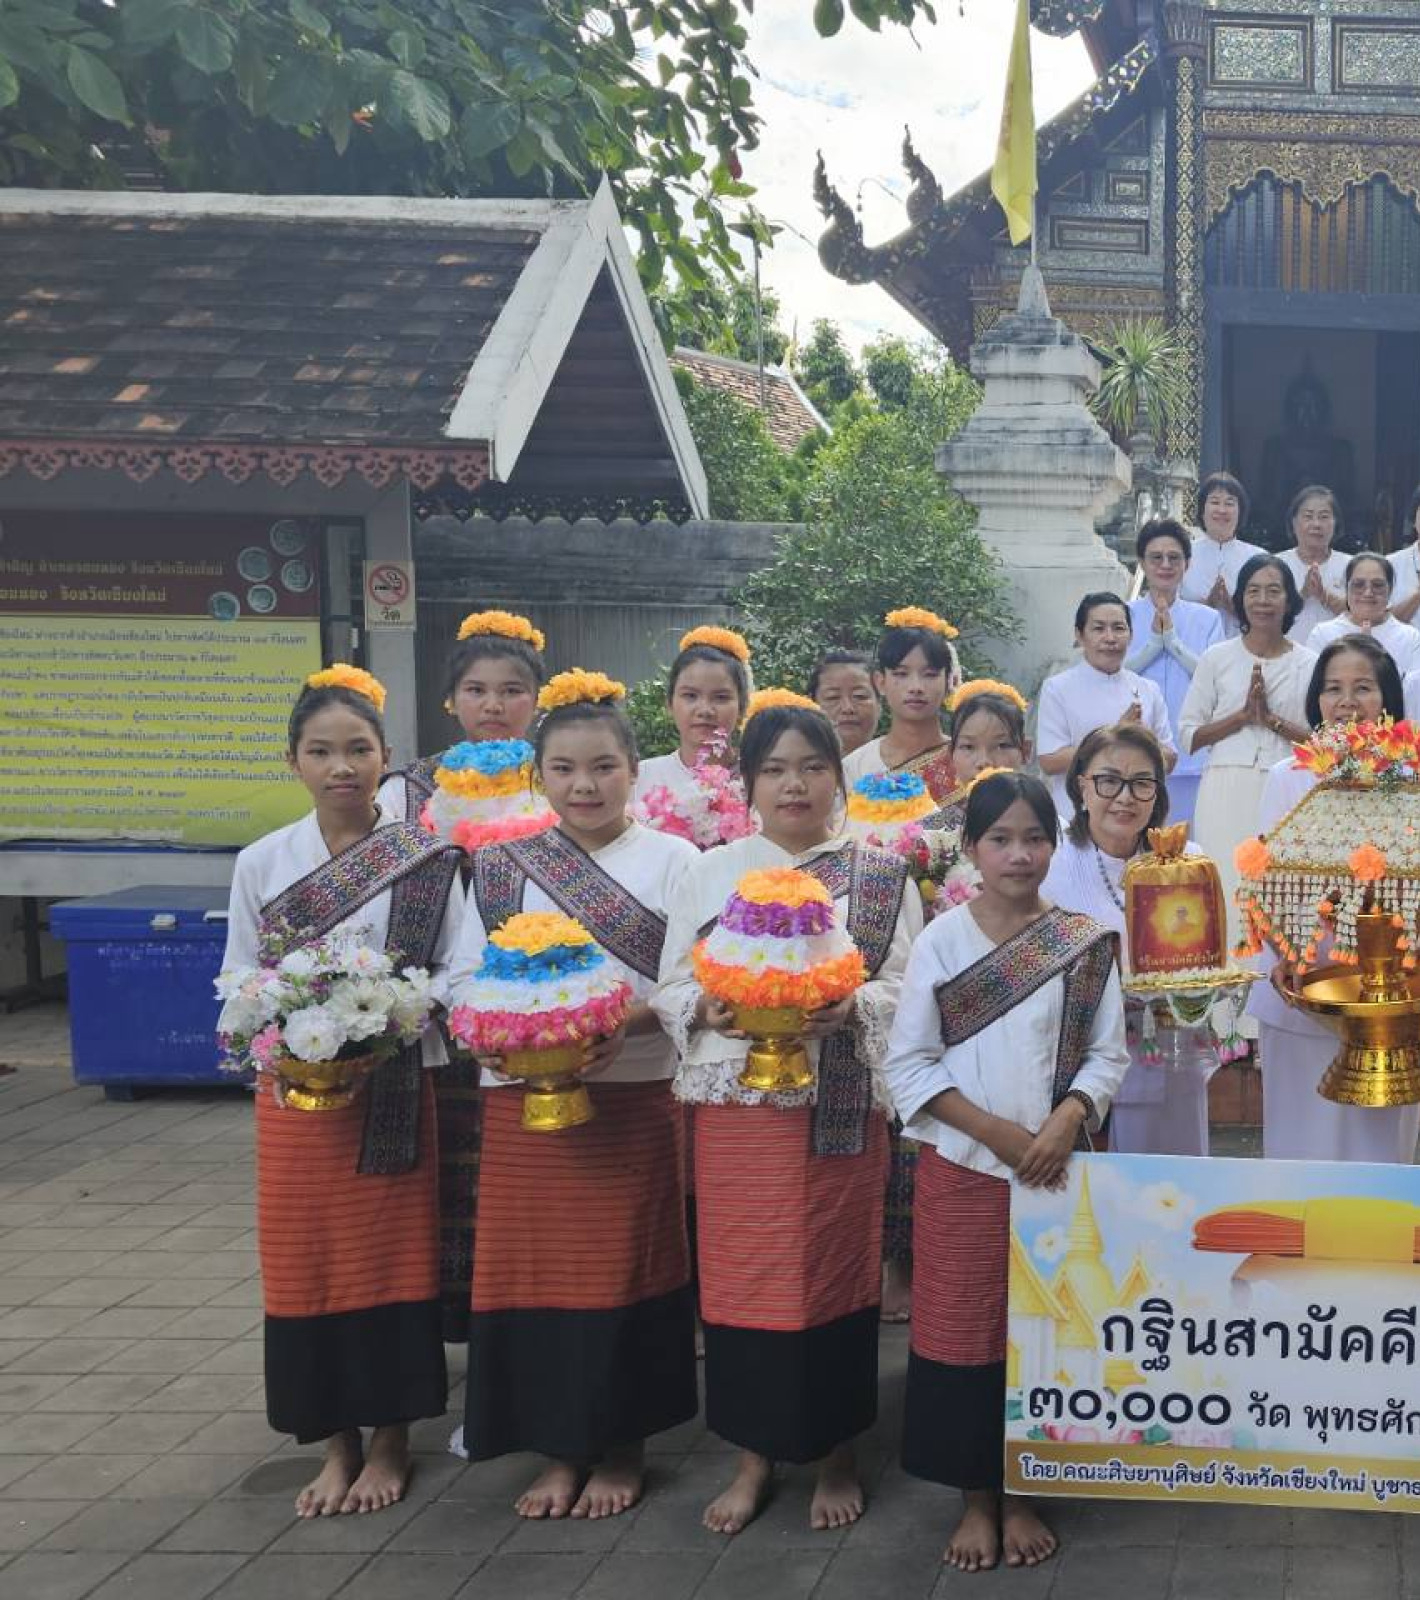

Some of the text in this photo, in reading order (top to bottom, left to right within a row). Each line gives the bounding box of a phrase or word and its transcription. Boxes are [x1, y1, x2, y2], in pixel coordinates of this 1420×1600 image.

[1029, 1387, 1231, 1430] ๓๐,๐๐๐
[1247, 1390, 1291, 1428] วัด
[1020, 1456, 1057, 1480] โดย
[1063, 1459, 1216, 1490] คณะศิษยานุศิษย์
[1223, 1464, 1367, 1493] จังหวัดเชียงใหม่
